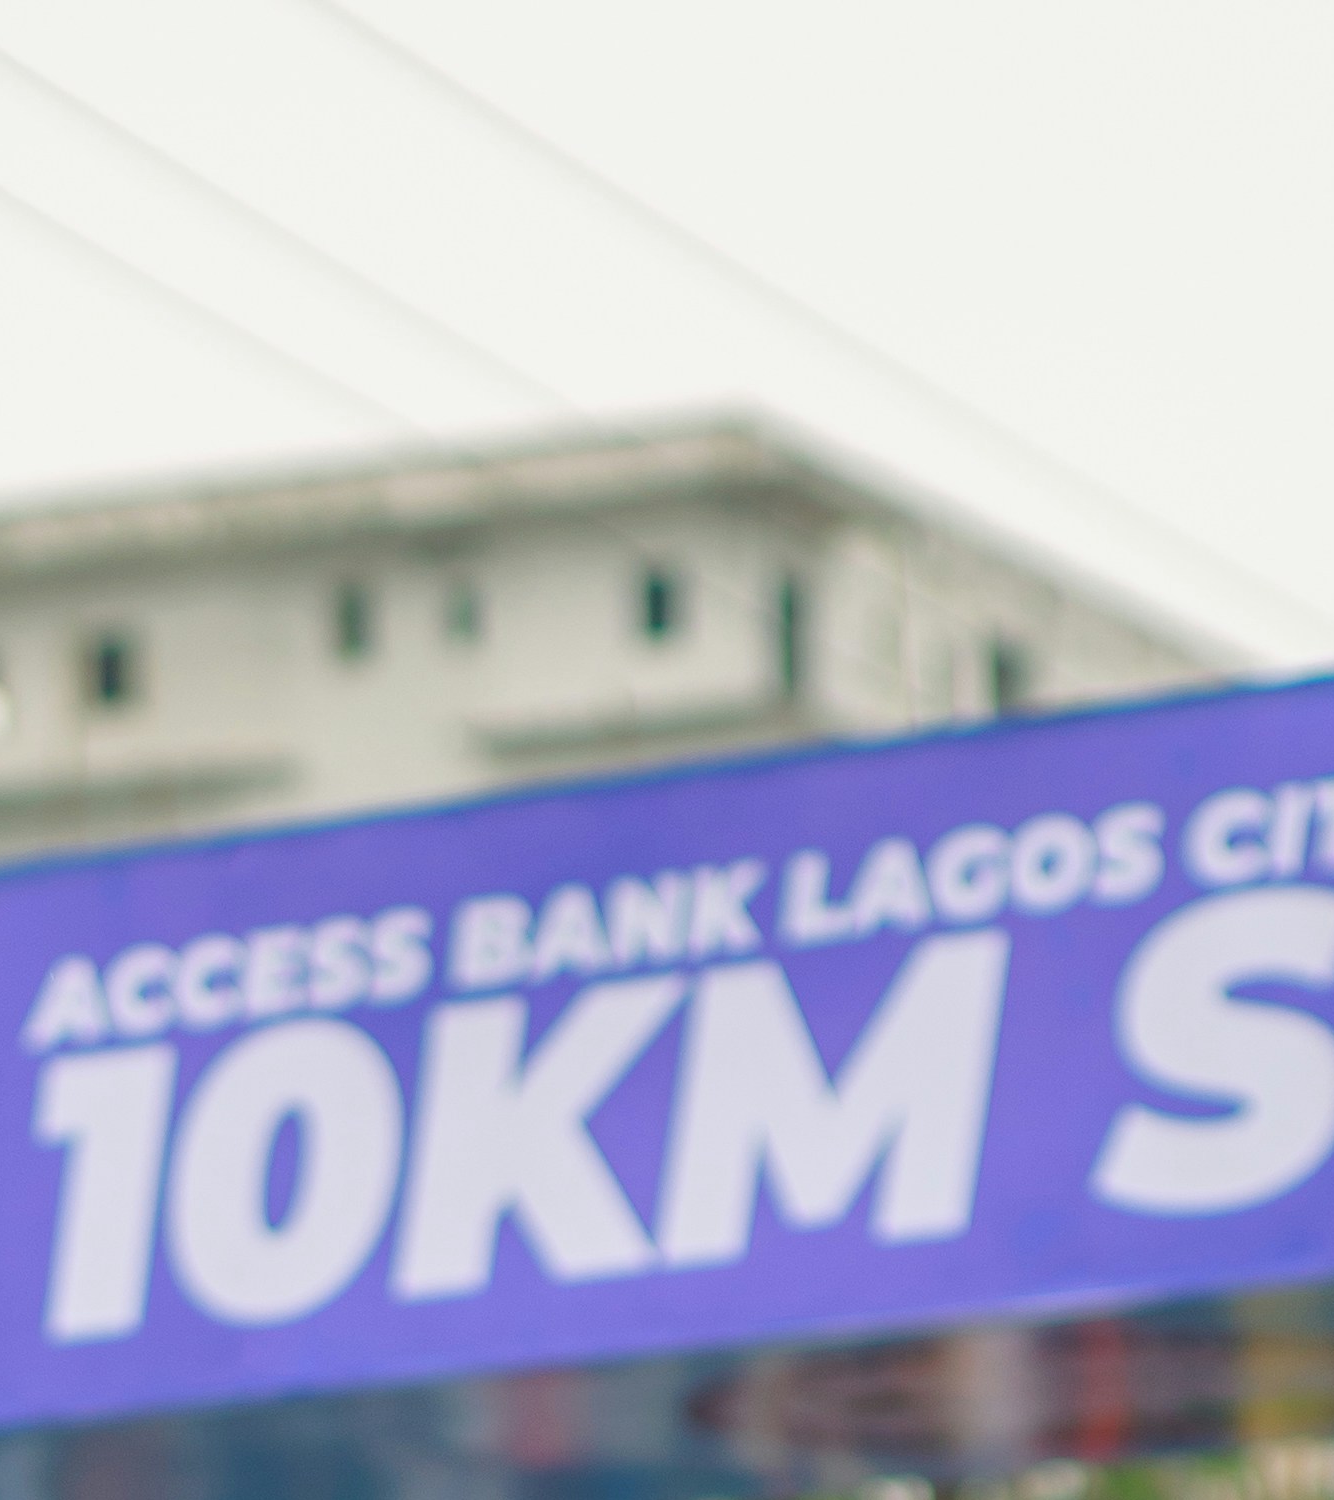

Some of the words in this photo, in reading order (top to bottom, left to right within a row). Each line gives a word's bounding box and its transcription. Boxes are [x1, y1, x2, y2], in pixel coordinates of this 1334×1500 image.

[24, 906, 433, 1053] ACCESS
[449, 857, 767, 994] BANK
[777, 801, 1167, 947] LAGOS
[34, 930, 1011, 1344] 10KM
